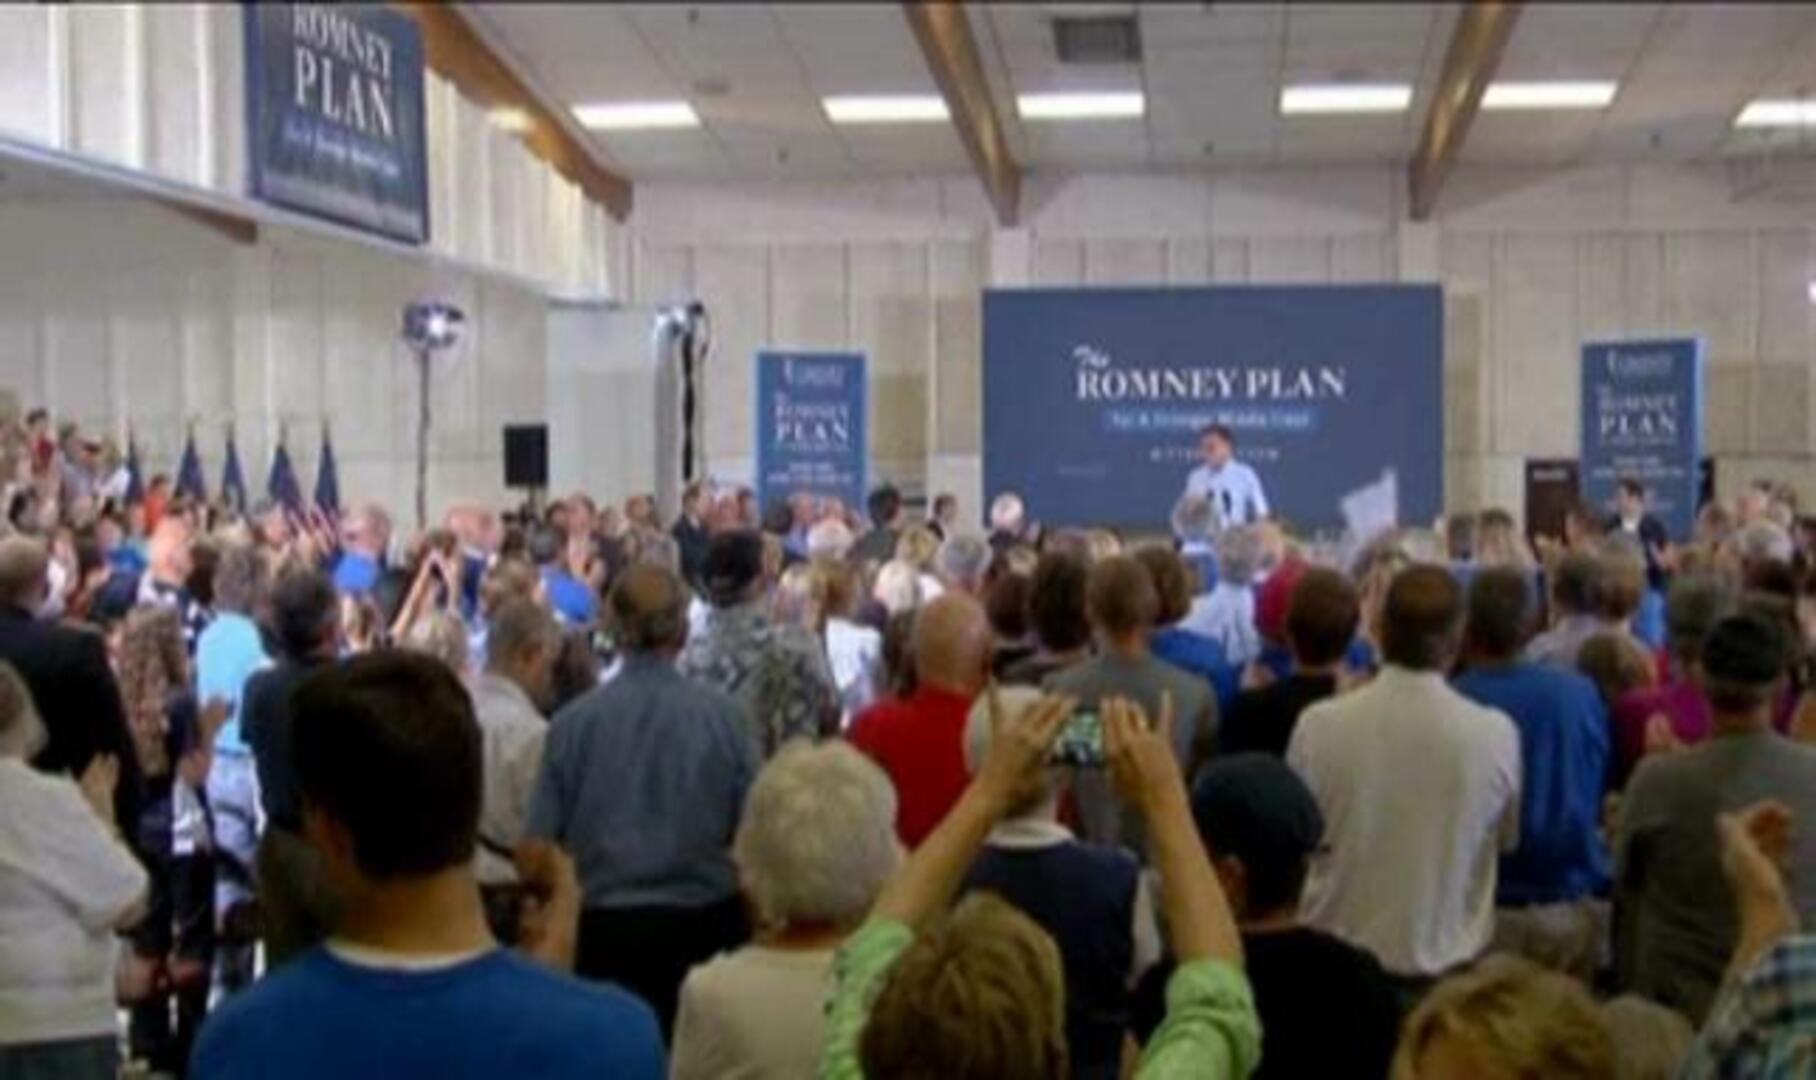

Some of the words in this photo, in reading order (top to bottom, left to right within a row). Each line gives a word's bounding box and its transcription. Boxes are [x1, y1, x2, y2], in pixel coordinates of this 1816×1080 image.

[292, 4, 393, 79] ROMNEY
[295, 47, 394, 137] PLAN
[1074, 345, 1111, 369] The
[1077, 367, 1238, 399] ROMNEY
[1246, 365, 1346, 399] PLAN
[774, 422, 849, 441] PLAN
[1600, 414, 1677, 435] PLAN
